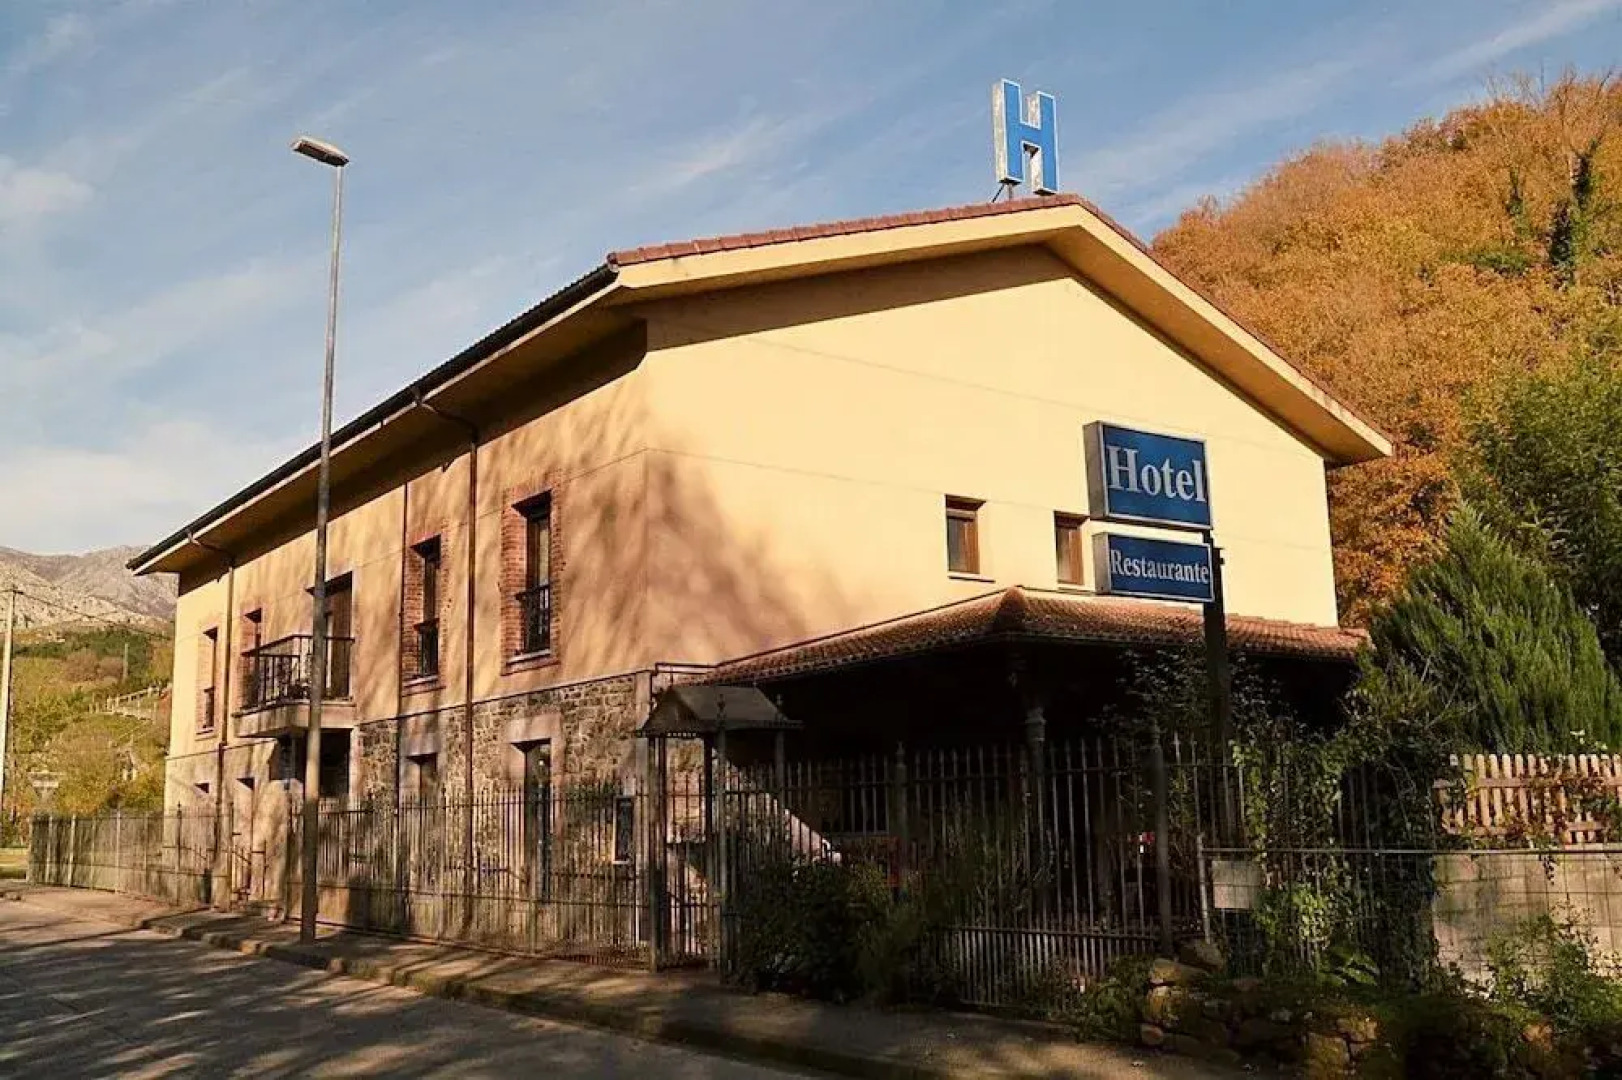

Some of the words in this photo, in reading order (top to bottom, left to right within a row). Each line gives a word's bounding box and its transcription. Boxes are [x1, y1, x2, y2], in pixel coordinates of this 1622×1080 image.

[999, 78, 1059, 193] H
[1107, 446, 1206, 502] Hotel
[1111, 550, 1209, 584] Restaurante
